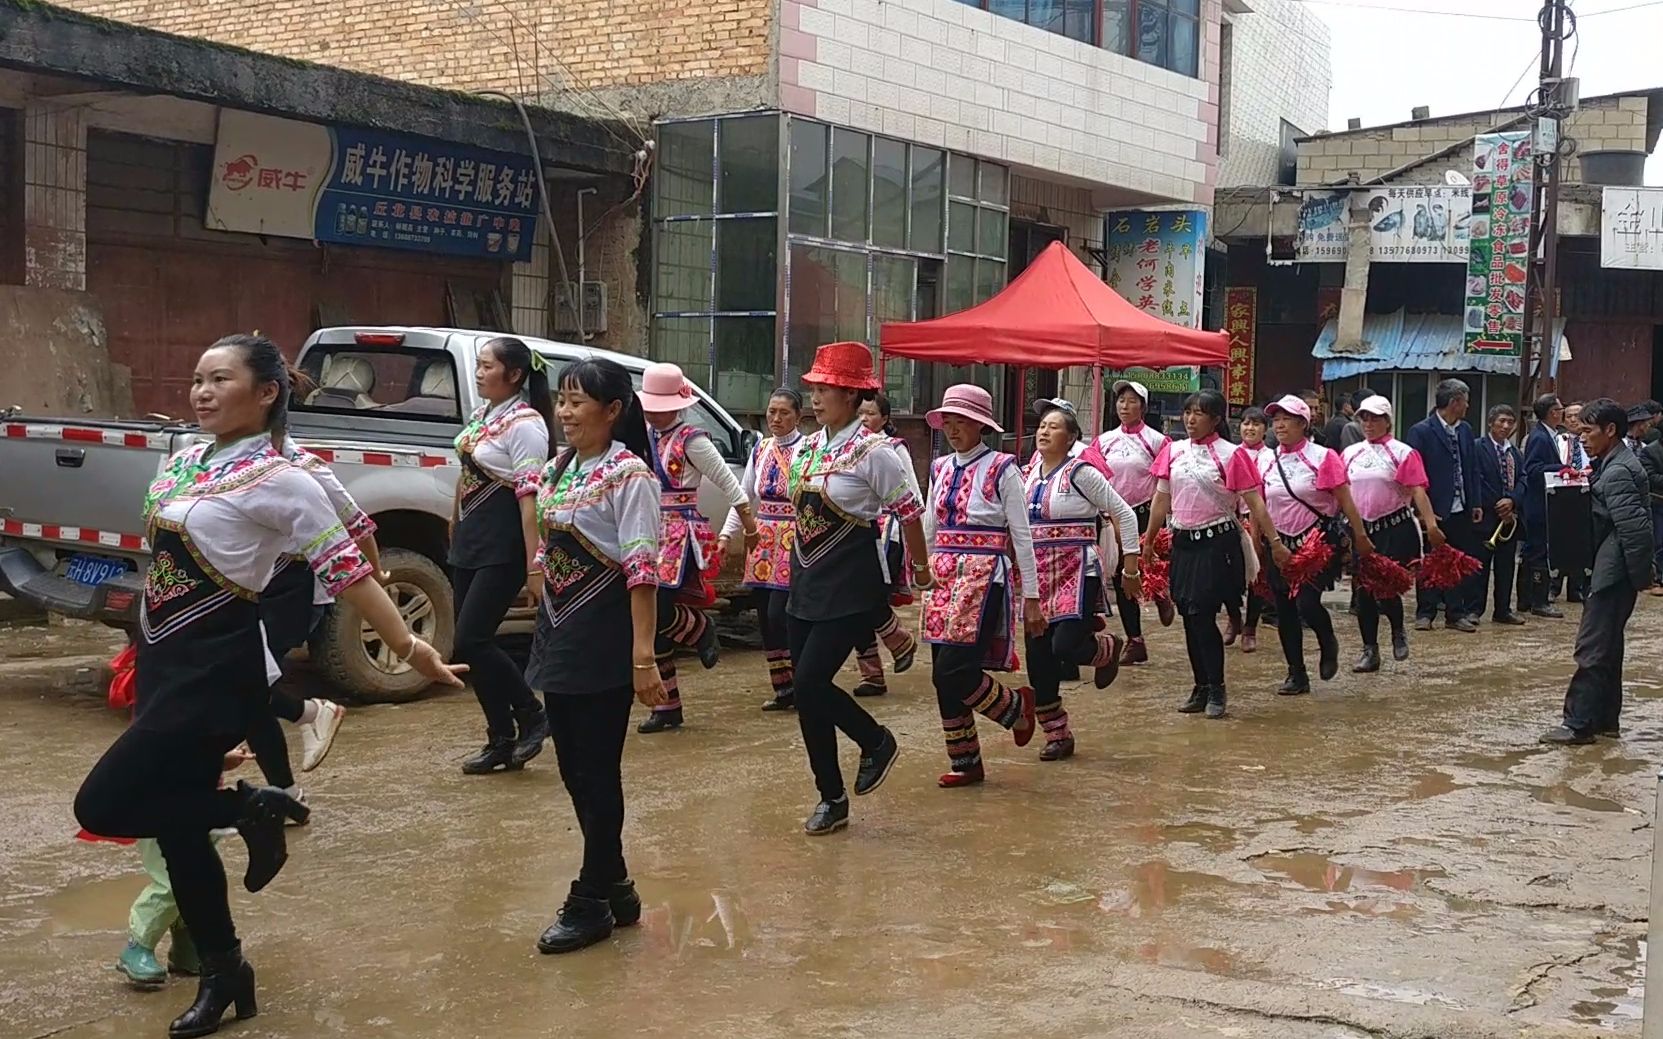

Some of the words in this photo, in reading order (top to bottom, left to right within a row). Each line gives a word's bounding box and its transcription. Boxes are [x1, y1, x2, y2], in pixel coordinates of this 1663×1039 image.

[257, 168, 308, 192] 威牛
[341, 142, 537, 209] 威牛作物科学服务站
[1111, 214, 1192, 234] 石岩头
